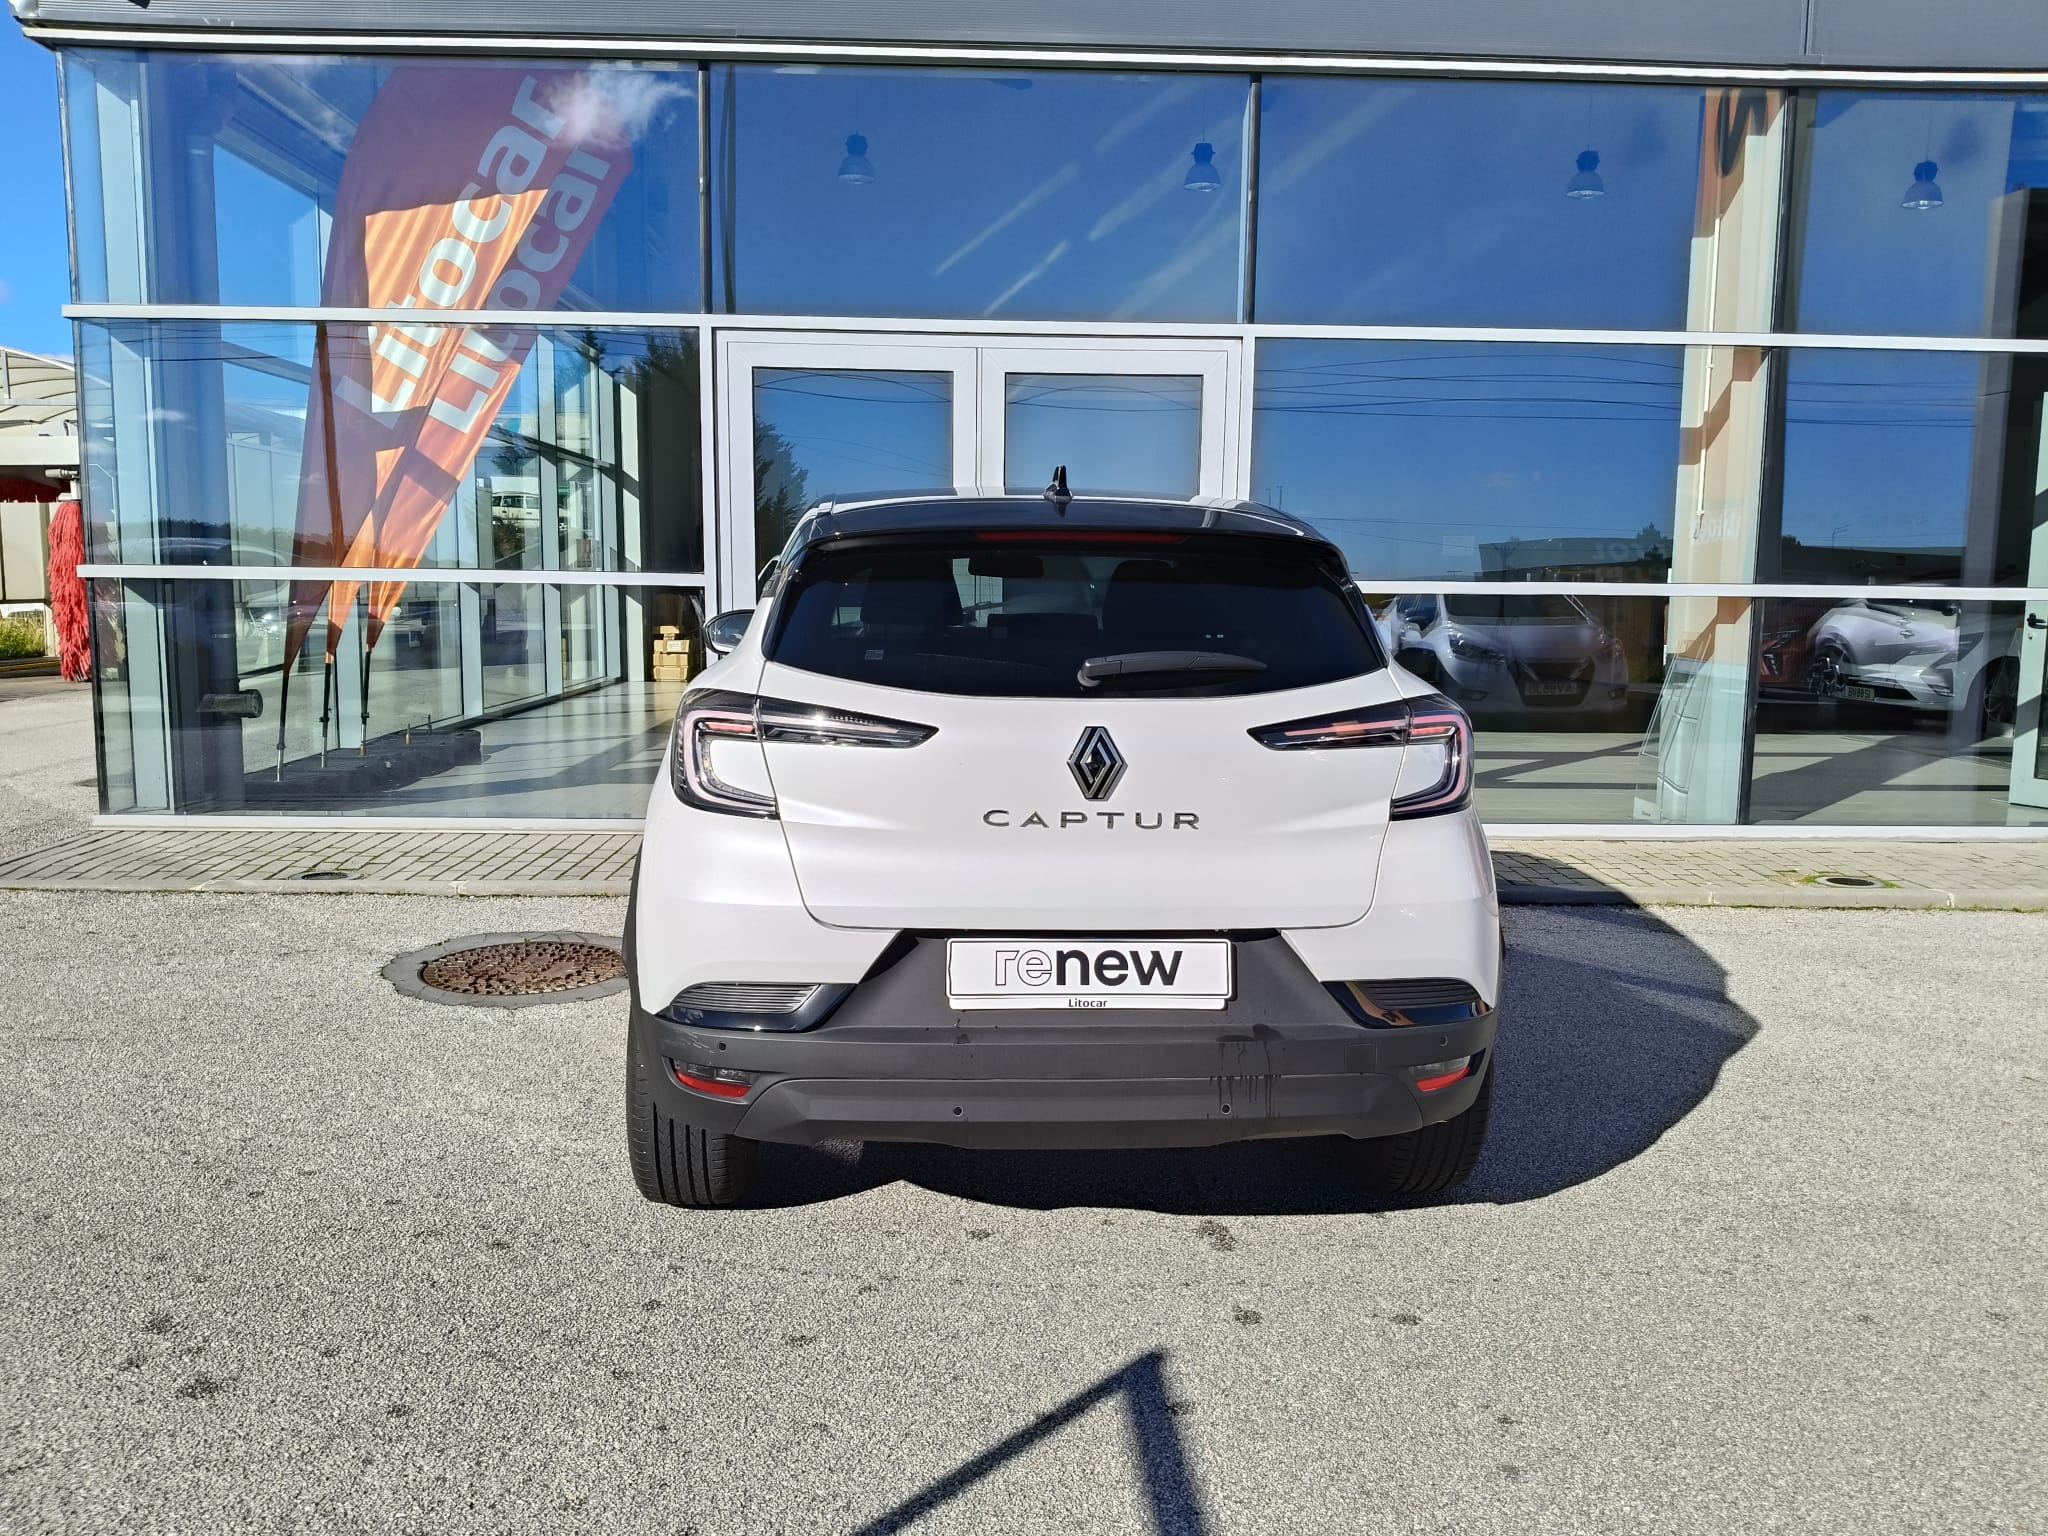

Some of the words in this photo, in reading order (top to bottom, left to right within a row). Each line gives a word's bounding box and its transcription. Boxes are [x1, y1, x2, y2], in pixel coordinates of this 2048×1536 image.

[334, 75, 567, 430] Litocar
[982, 809, 1200, 830] CAPTUR
[994, 948, 1184, 987] renew
[1067, 997, 1109, 1009] Litocar
